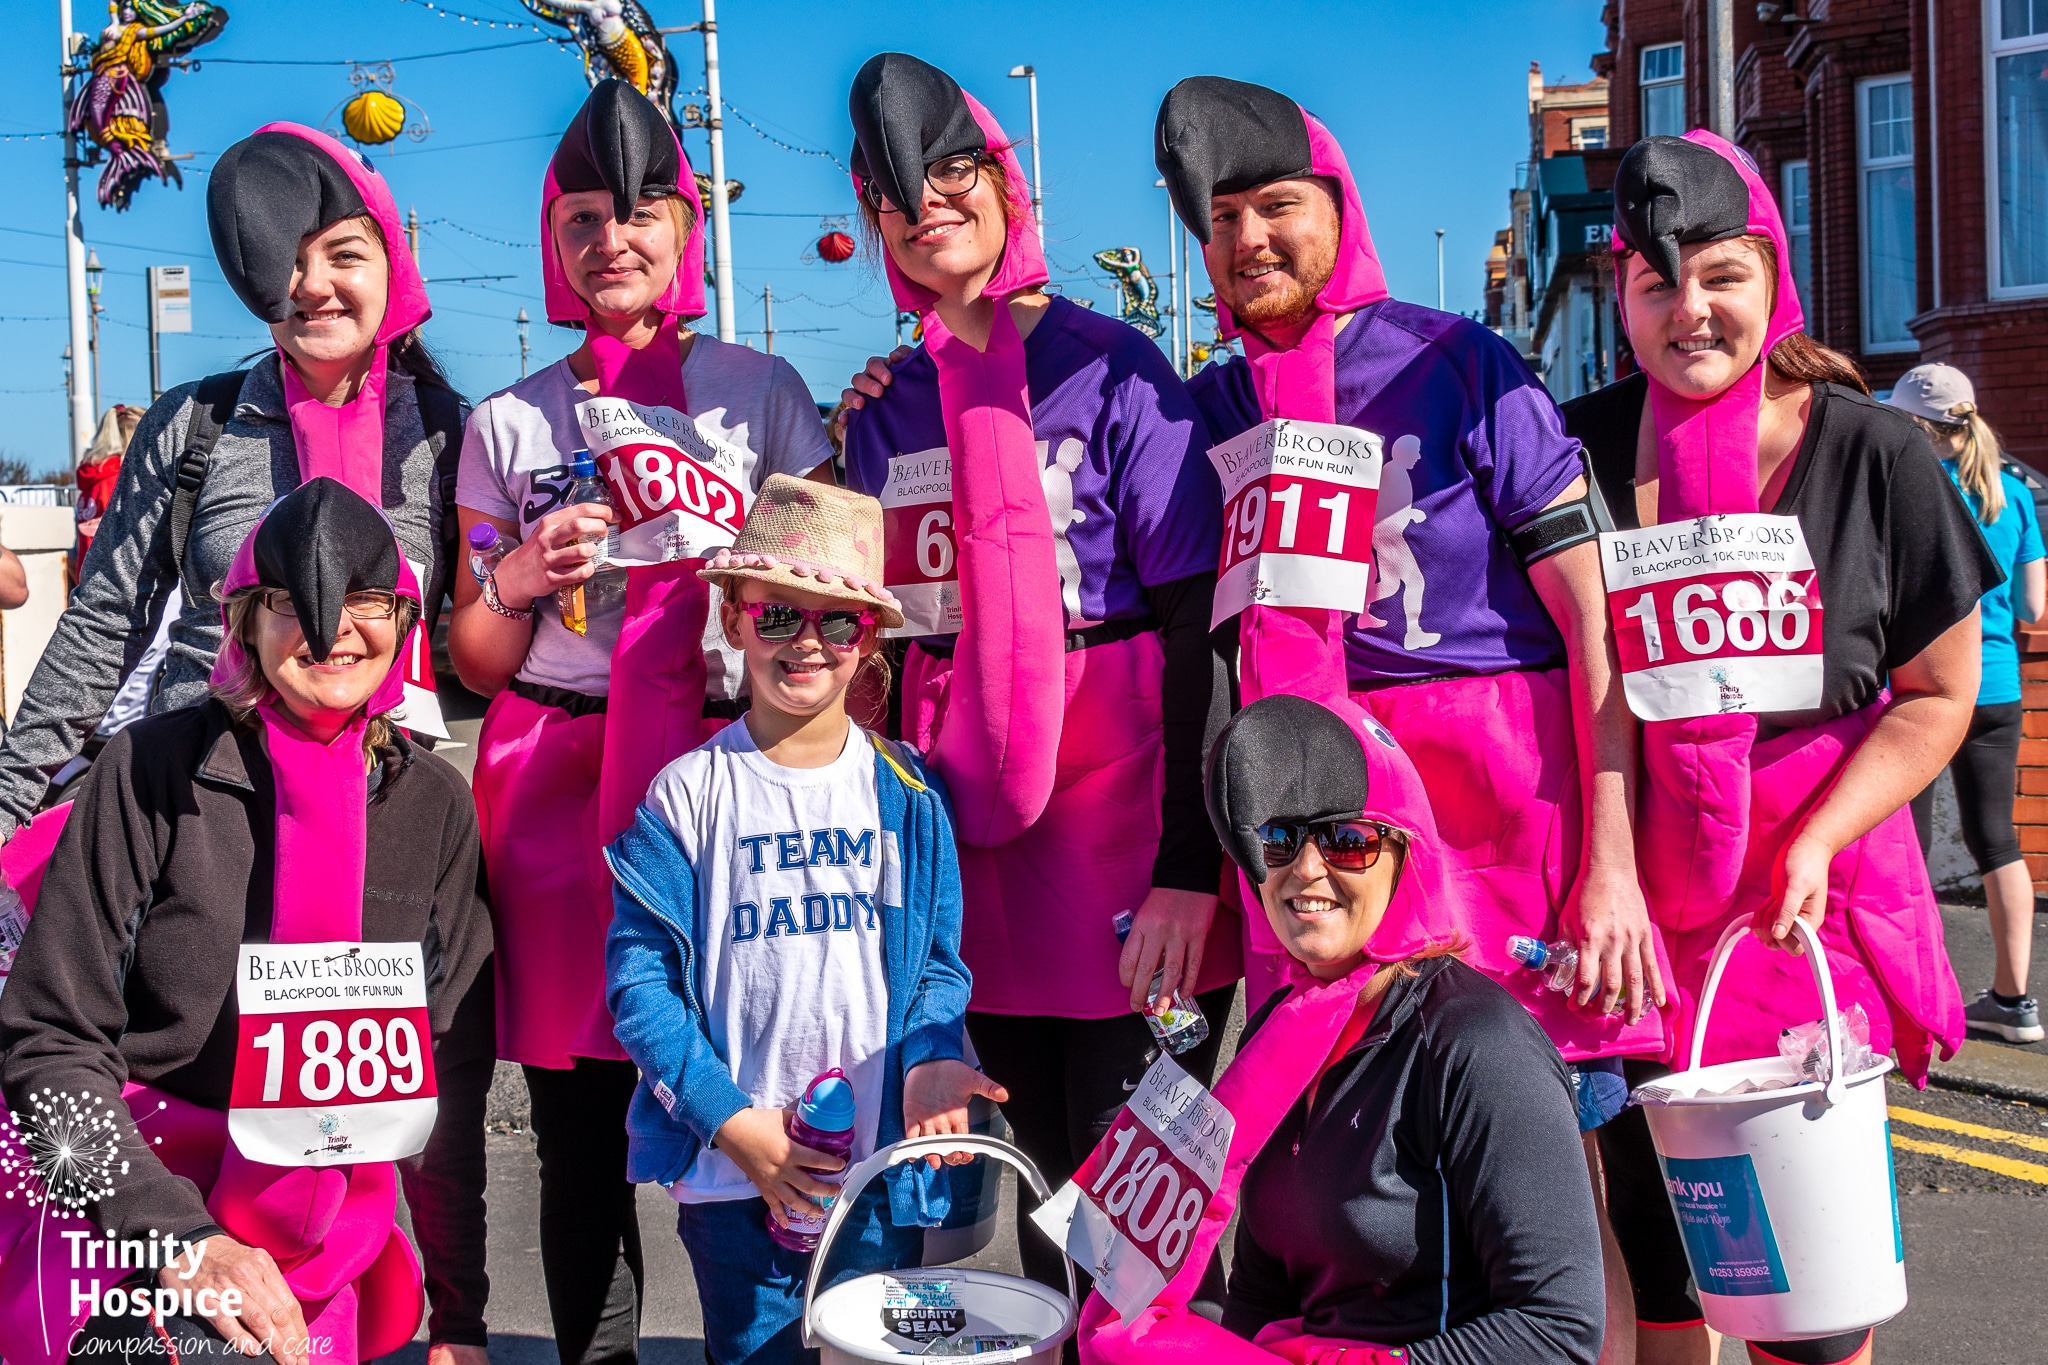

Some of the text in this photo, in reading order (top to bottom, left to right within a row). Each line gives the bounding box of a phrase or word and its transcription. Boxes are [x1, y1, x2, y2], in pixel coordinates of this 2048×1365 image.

[587, 407, 736, 467] BEAVERBROOKS
[601, 425, 727, 473] BLACKPOOL 10K FUN RUN
[1220, 432, 1373, 475] BEAVERBROOKS
[1234, 455, 1354, 486] BLACKPOOL 10K FUN RUN
[608, 449, 740, 537] 1802
[916, 510, 956, 578] 6
[1226, 483, 1350, 568] 1911
[1612, 526, 1795, 563] BEAVERBROOKS
[1632, 551, 1785, 576] BLACKPOOL 10K FUN RUN
[1625, 580, 1810, 663] 1686
[739, 828, 876, 874] TEAM
[731, 892, 876, 944] DADDY
[249, 954, 414, 981] BEAVERBROOKS
[264, 985, 403, 1001] BLACKPOOL 10K FUN RUN
[253, 1017, 424, 1102] 1889
[328, 1135, 348, 1144] Trinity
[1187, 1137, 1203, 1160] FUN
[1204, 1153, 1218, 1173] RUN
[1091, 1125, 1204, 1268] 1808
[1665, 1176, 1724, 1201] ank you
[1709, 1266, 1771, 1277] 01253 359362
[892, 1309, 957, 1319] SECURITY
[897, 1320, 956, 1333] SEAL
